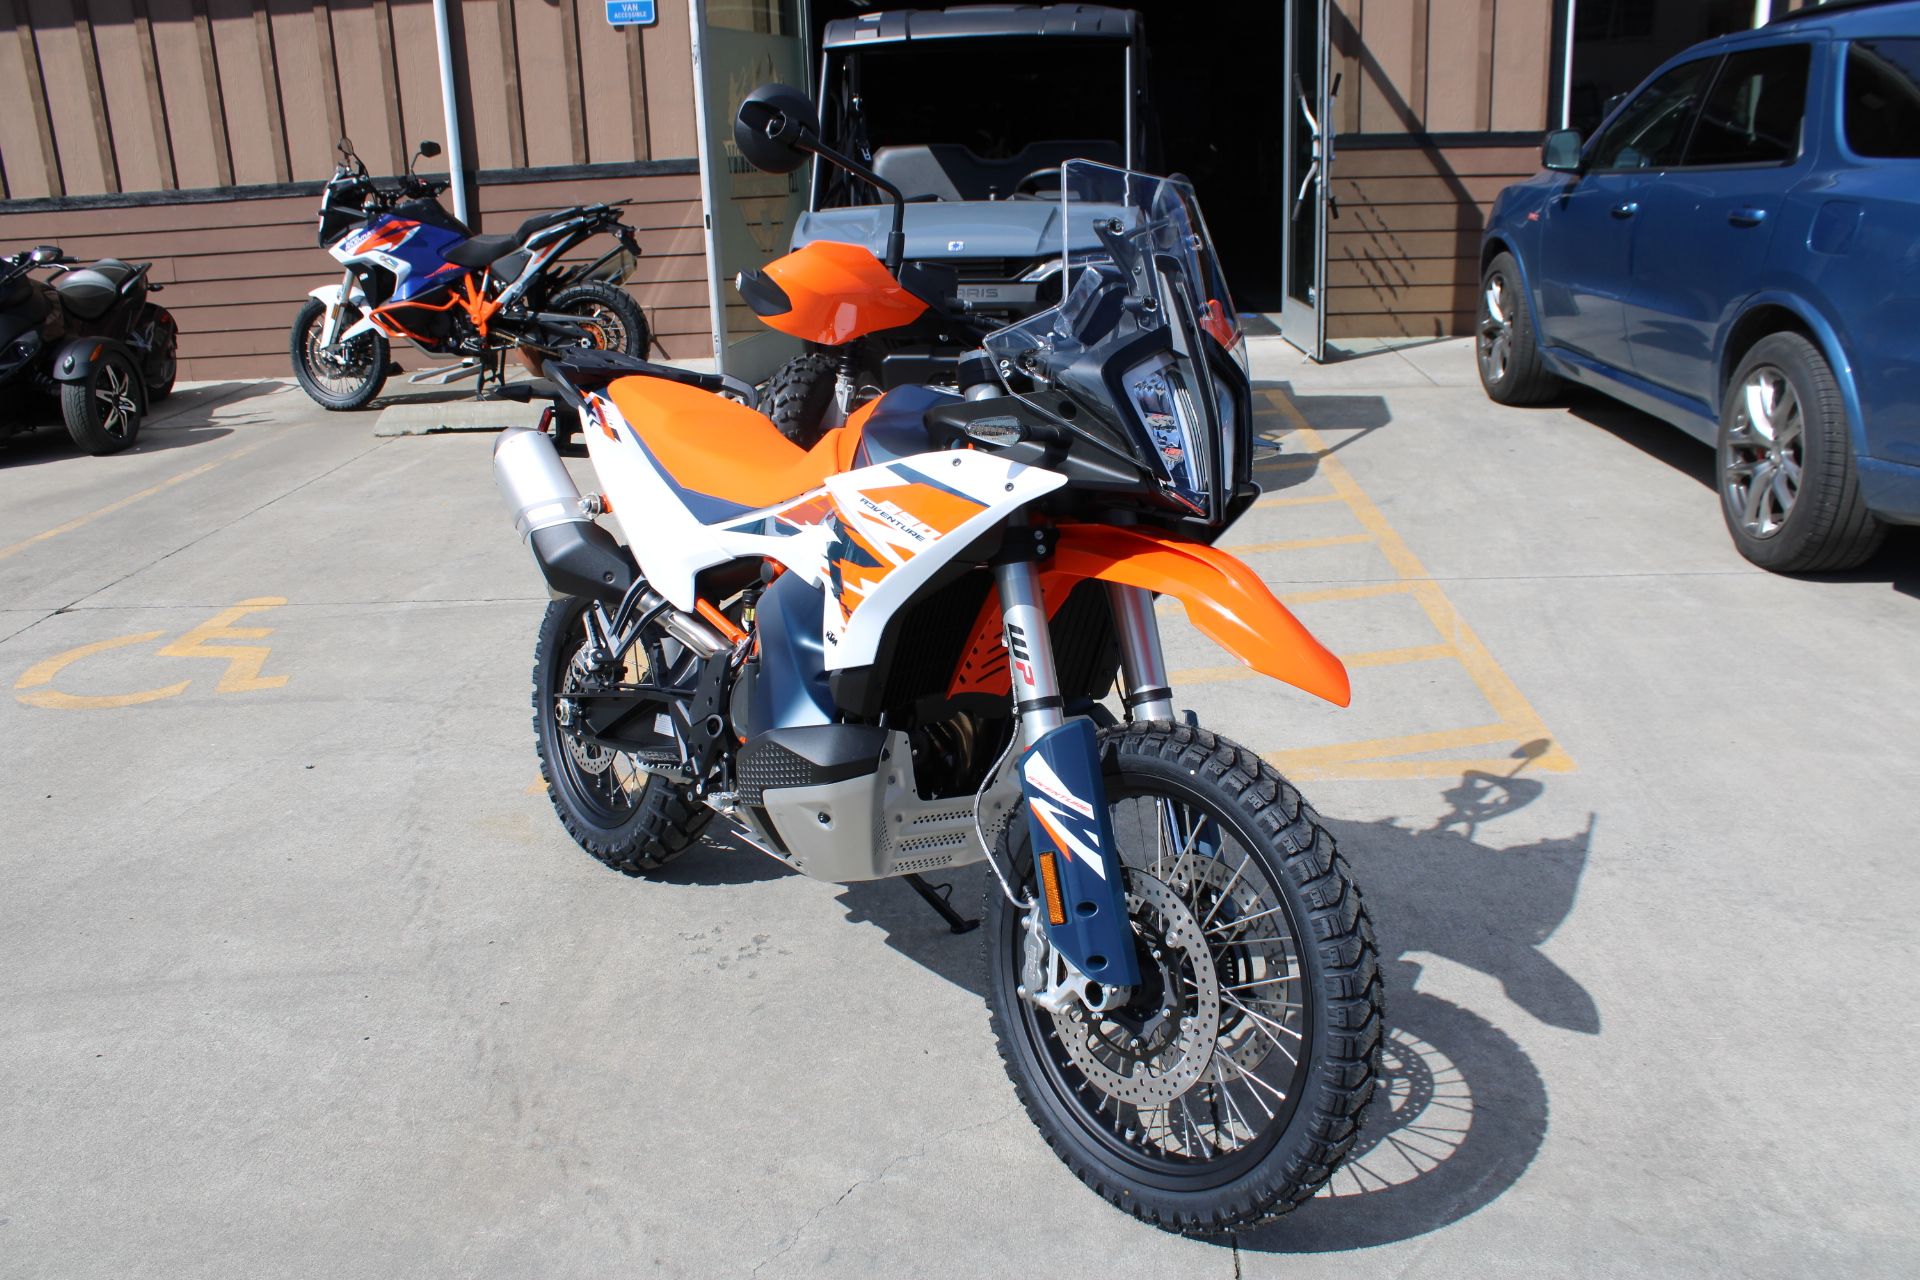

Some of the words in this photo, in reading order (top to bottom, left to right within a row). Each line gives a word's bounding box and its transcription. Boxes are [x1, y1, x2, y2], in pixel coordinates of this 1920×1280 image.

[621, 3, 638, 12] VAN
[859, 498, 926, 542] ADVENTURE
[825, 630, 838, 646] KTM
[1007, 623, 1035, 687] WP
